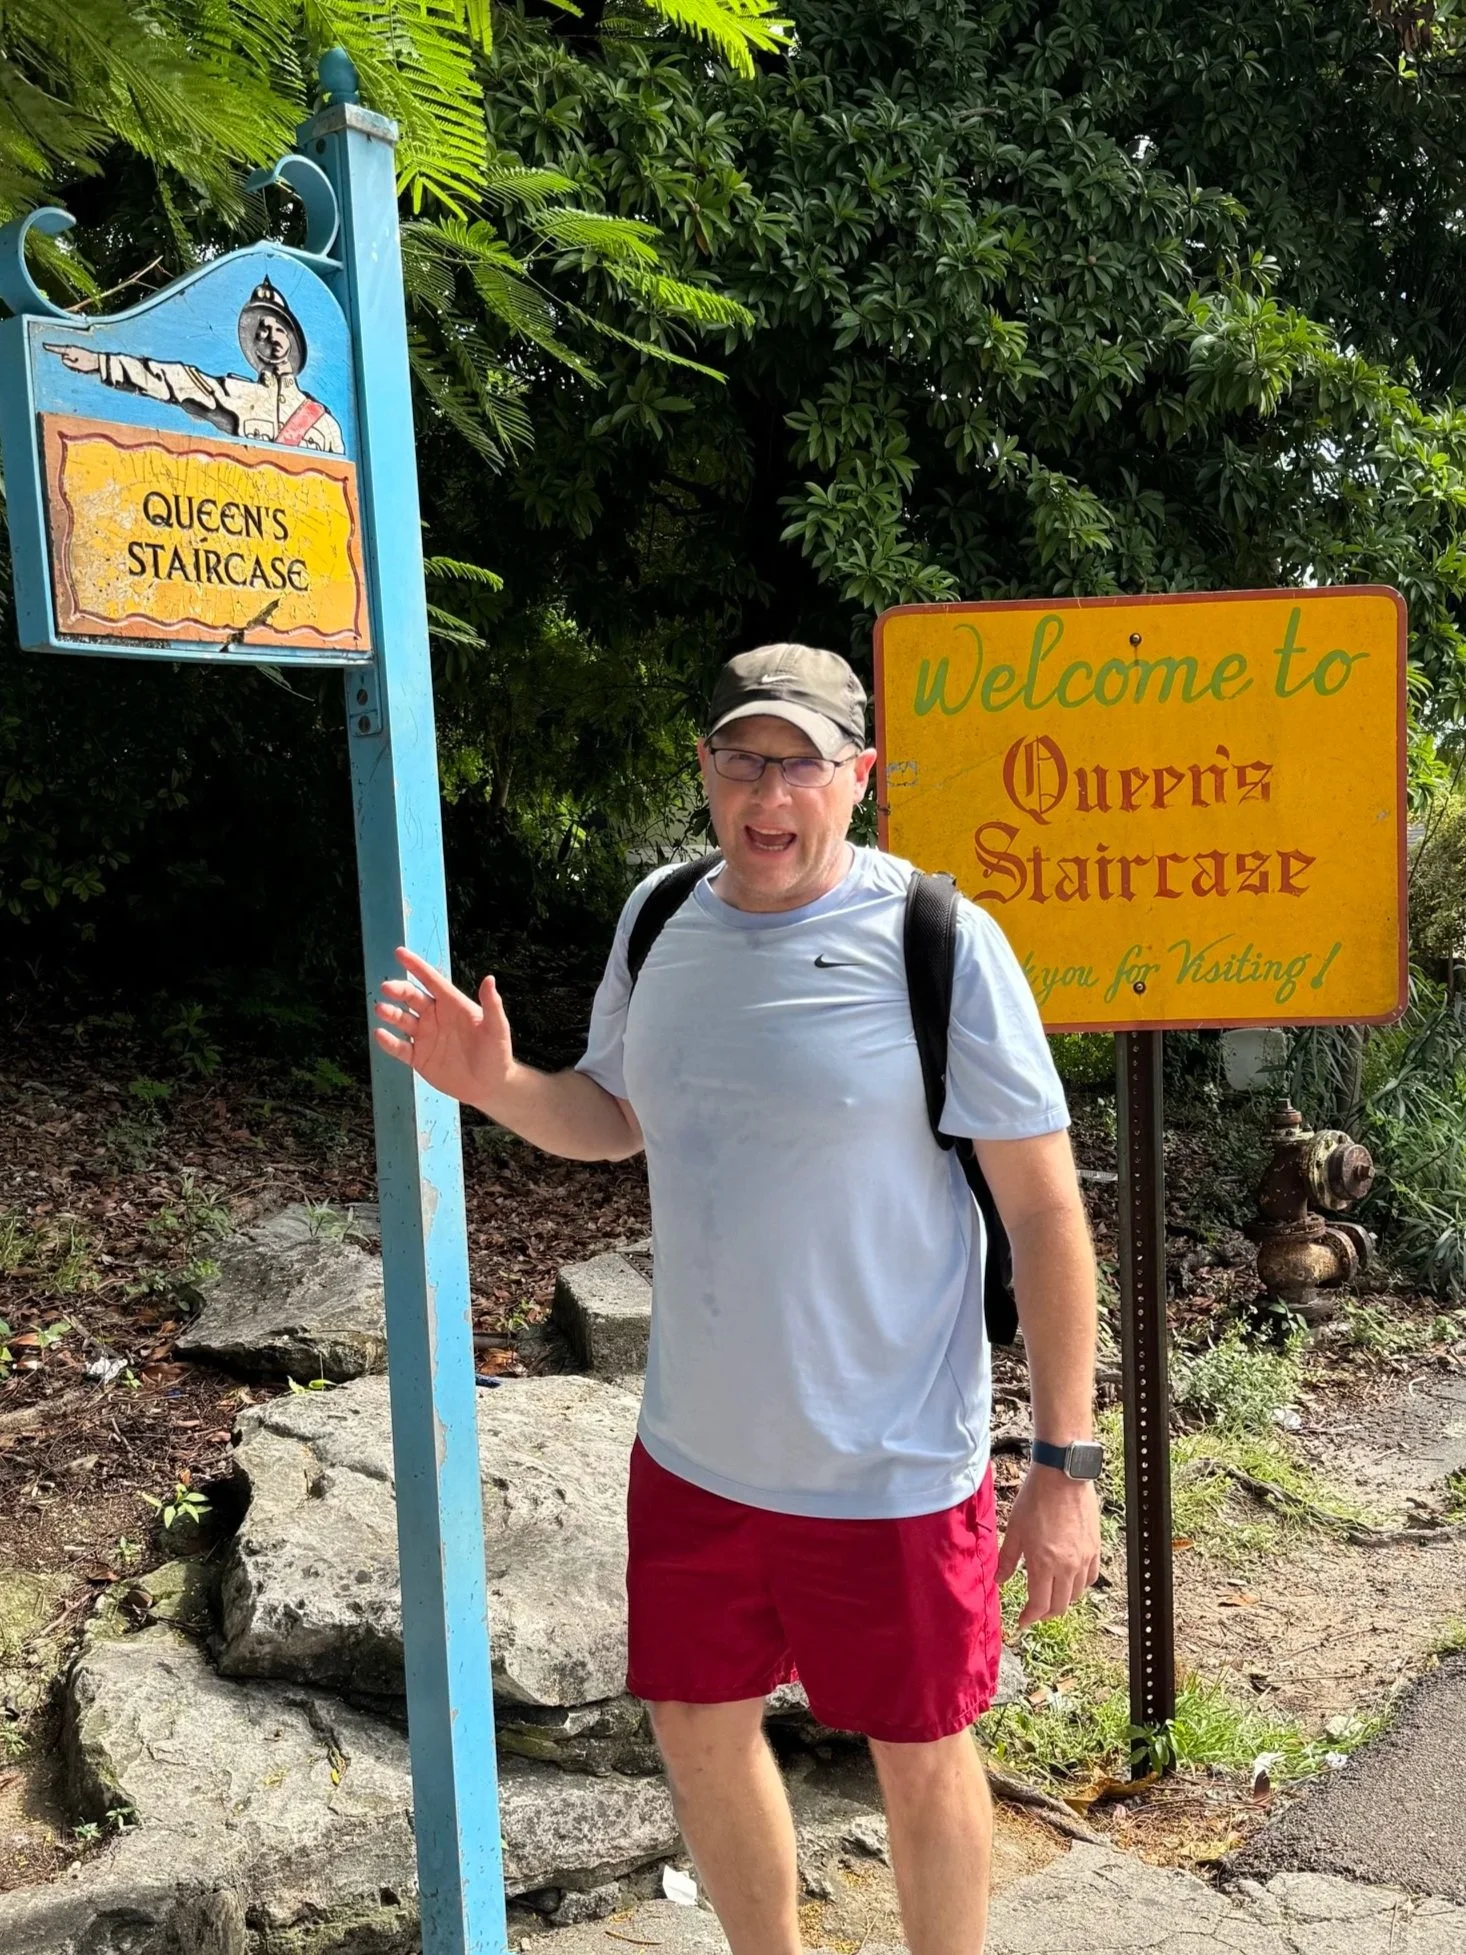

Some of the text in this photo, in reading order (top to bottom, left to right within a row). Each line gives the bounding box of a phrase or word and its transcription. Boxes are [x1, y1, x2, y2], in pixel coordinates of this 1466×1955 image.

[142, 490, 289, 542] QUEEN'S
[127, 538, 310, 592] STAIRCASE
[912, 606, 1371, 717] Welcome to
[1001, 733, 1275, 826] Queen's
[972, 820, 1317, 904] Staircase
[1034, 962, 1101, 1008] you
[1103, 943, 1161, 1004] for
[1167, 932, 1343, 1004] Visiting!
